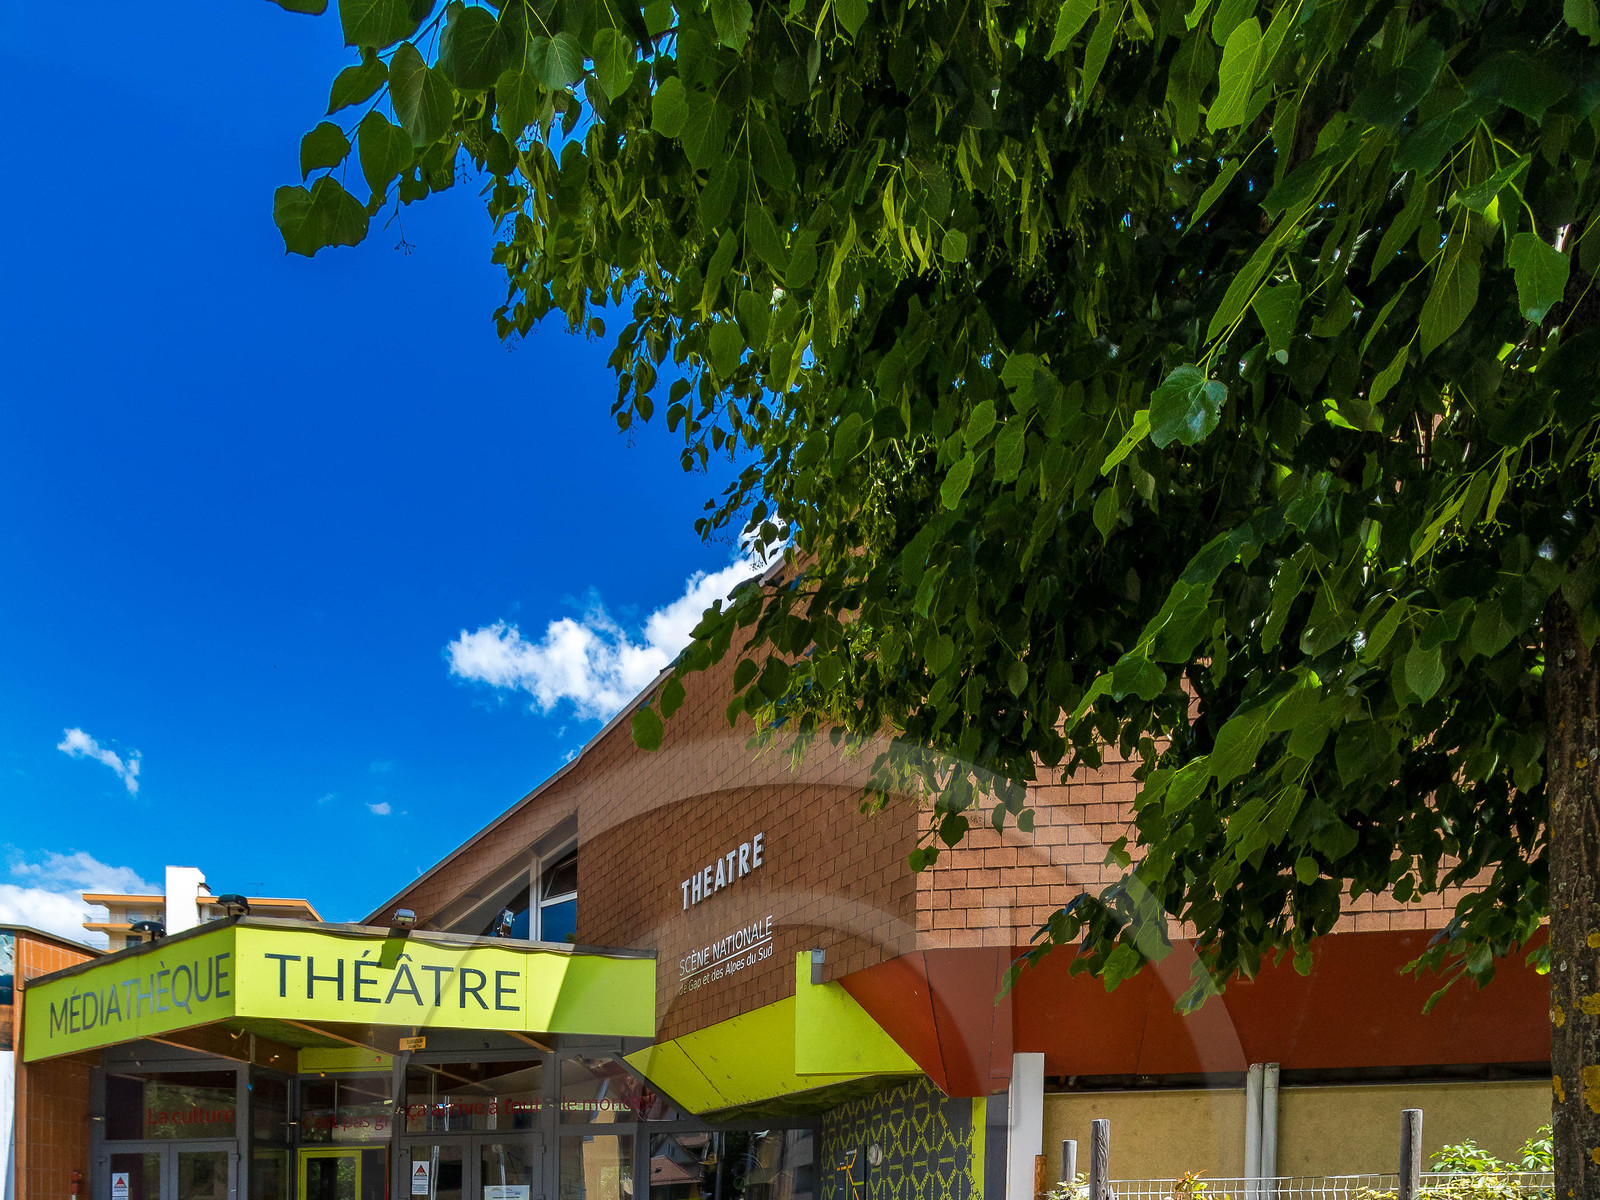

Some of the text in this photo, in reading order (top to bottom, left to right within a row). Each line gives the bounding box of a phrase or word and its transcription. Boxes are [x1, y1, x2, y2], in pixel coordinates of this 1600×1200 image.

[681, 832, 764, 910] THEATRE
[678, 943, 773, 995] de Gap et des Alpes du Sud
[679, 915, 772, 976] SCÈNE NATIONALE
[50, 952, 231, 1038] MÉDIATHÈQUE
[265, 950, 520, 1011] THÉÂTRE
[147, 1108, 167, 1125] La
[172, 1107, 235, 1124] culture
[342, 1116, 370, 1131] pas
[374, 1113, 391, 1130] gr
[431, 1098, 485, 1116] arrive
[504, 1099, 540, 1115] tout
[561, 1097, 576, 1112] le
